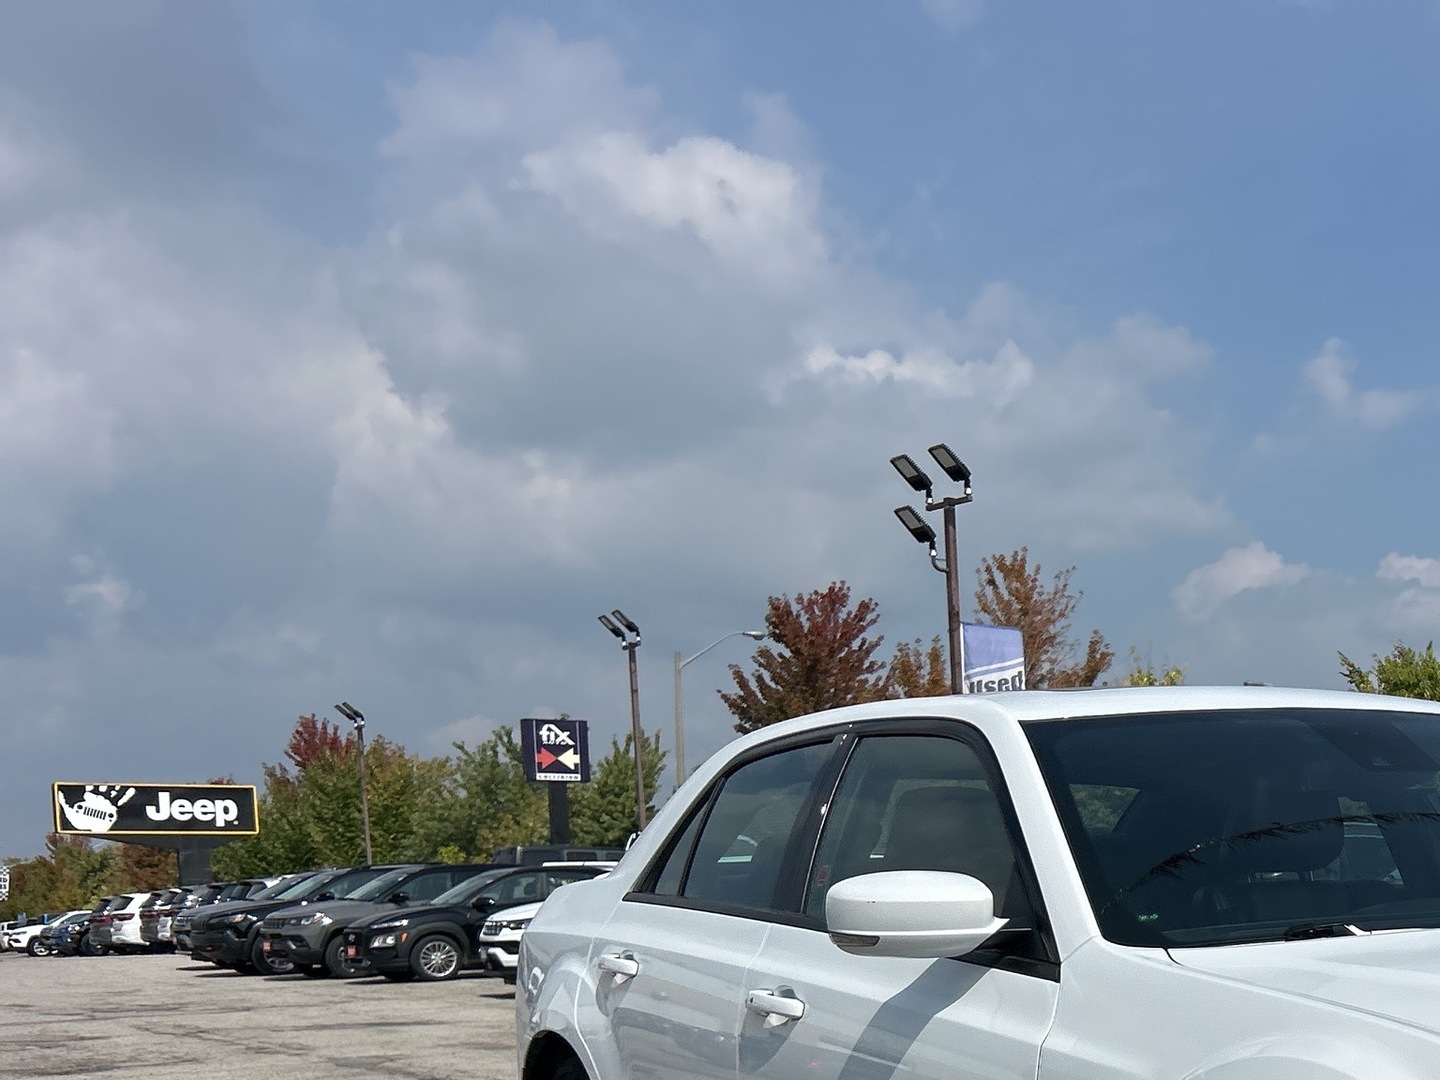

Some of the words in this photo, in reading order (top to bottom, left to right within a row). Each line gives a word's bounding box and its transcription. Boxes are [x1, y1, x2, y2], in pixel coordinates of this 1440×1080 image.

[970, 670, 1023, 693] Used
[539, 723, 576, 745] fix
[145, 791, 239, 828] Jeep
